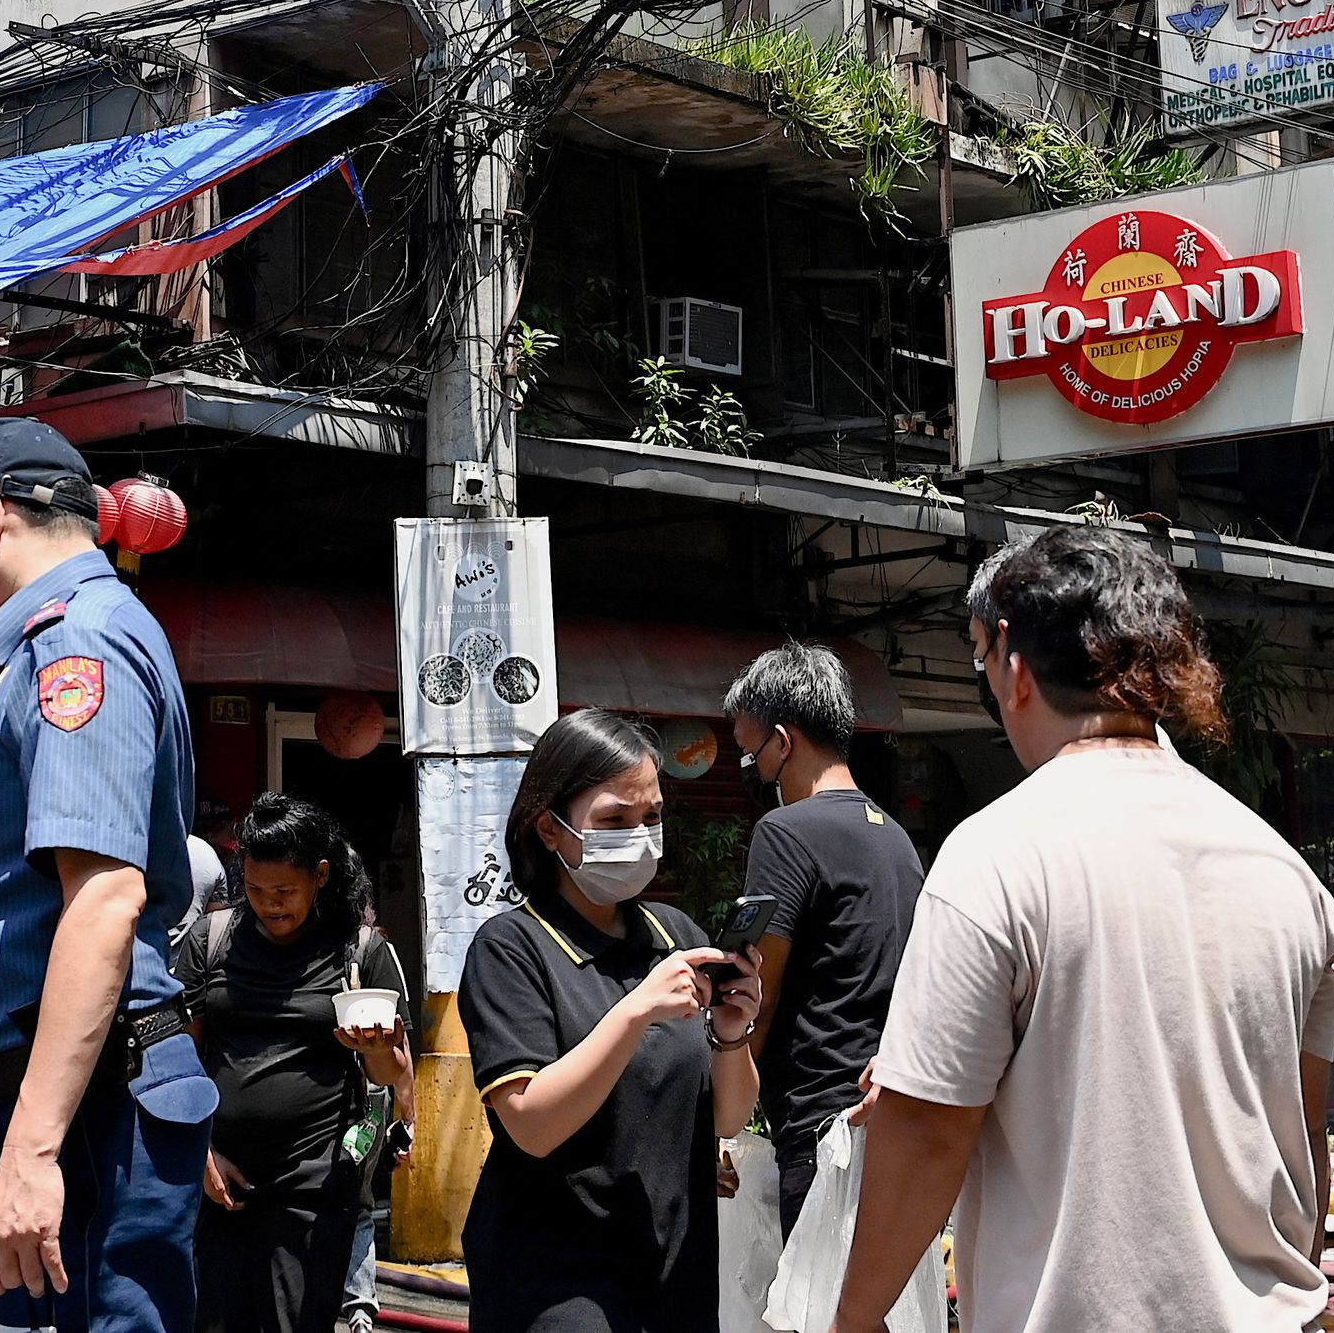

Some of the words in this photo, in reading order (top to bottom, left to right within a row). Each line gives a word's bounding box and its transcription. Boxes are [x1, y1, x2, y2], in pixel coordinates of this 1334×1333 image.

[1209, 64, 1238, 83] BAG
[1246, 62, 1258, 76] &
[1268, 44, 1333, 72] LUGGAGE
[1167, 86, 1225, 110] MEDICAL
[1245, 68, 1311, 95] HOSPITAL
[1100, 272, 1165, 295] CHINESE
[986, 266, 1281, 364] HO-LAND
[1090, 334, 1179, 360] DELICACIES
[1060, 363, 1090, 398] HOME
[1091, 389, 1110, 406] OF
[1112, 378, 1182, 409] DELICIOUS
[1182, 339, 1212, 385] HOPIA
[457, 604, 472, 614] AND
[474, 602, 519, 614] RESTAURANT
[468, 617, 503, 628] CHINESE
[43, 657, 97, 684] MANILA'S
[51, 711, 89, 727] FINEST
